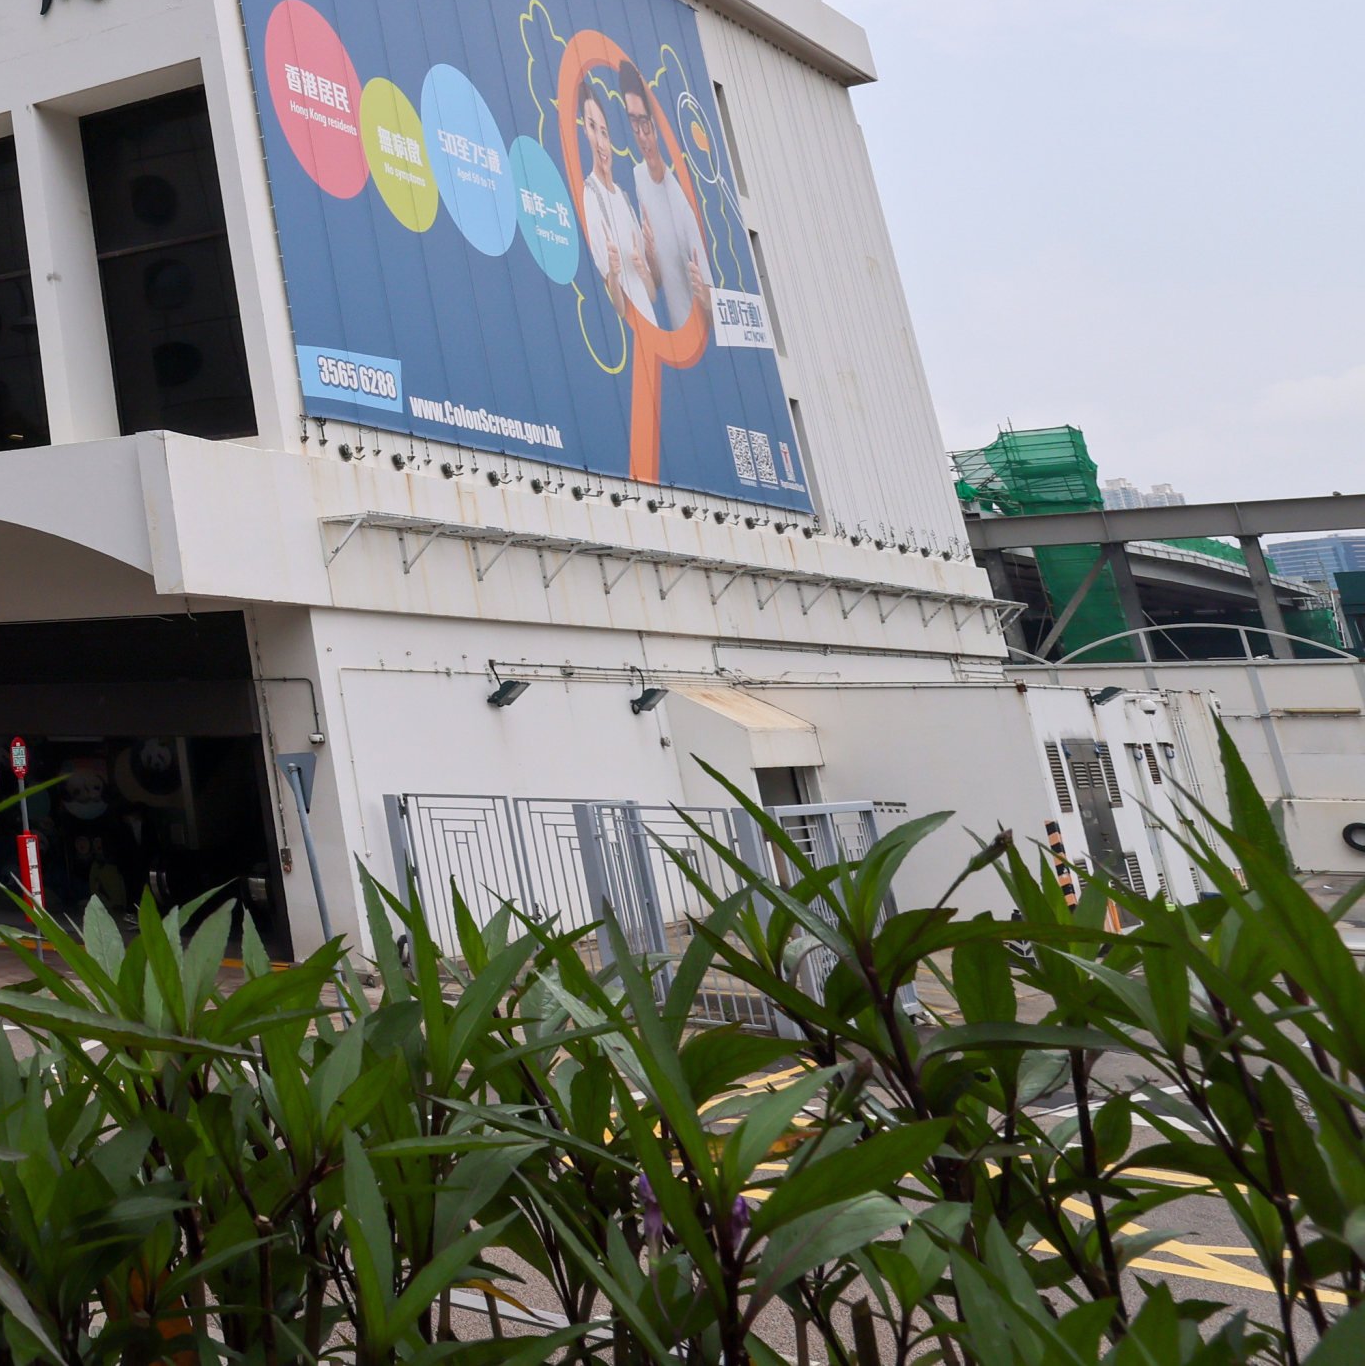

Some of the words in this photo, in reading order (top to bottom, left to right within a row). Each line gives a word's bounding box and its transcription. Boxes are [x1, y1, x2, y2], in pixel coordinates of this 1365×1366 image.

[285, 63, 351, 113] 香港居民
[290, 100, 309, 119] Hong
[309, 107, 327, 127] Kong
[328, 117, 357, 136] residents
[384, 162, 394, 175] No
[437, 129, 502, 175] 50至75歲
[520, 188, 571, 228] 兩年一次
[717, 298, 764, 328] 立即行動!
[317, 355, 359, 391] 3565
[358, 366, 397, 400] 6288
[409, 396, 564, 449] www.ColonScreen.gov.hk
